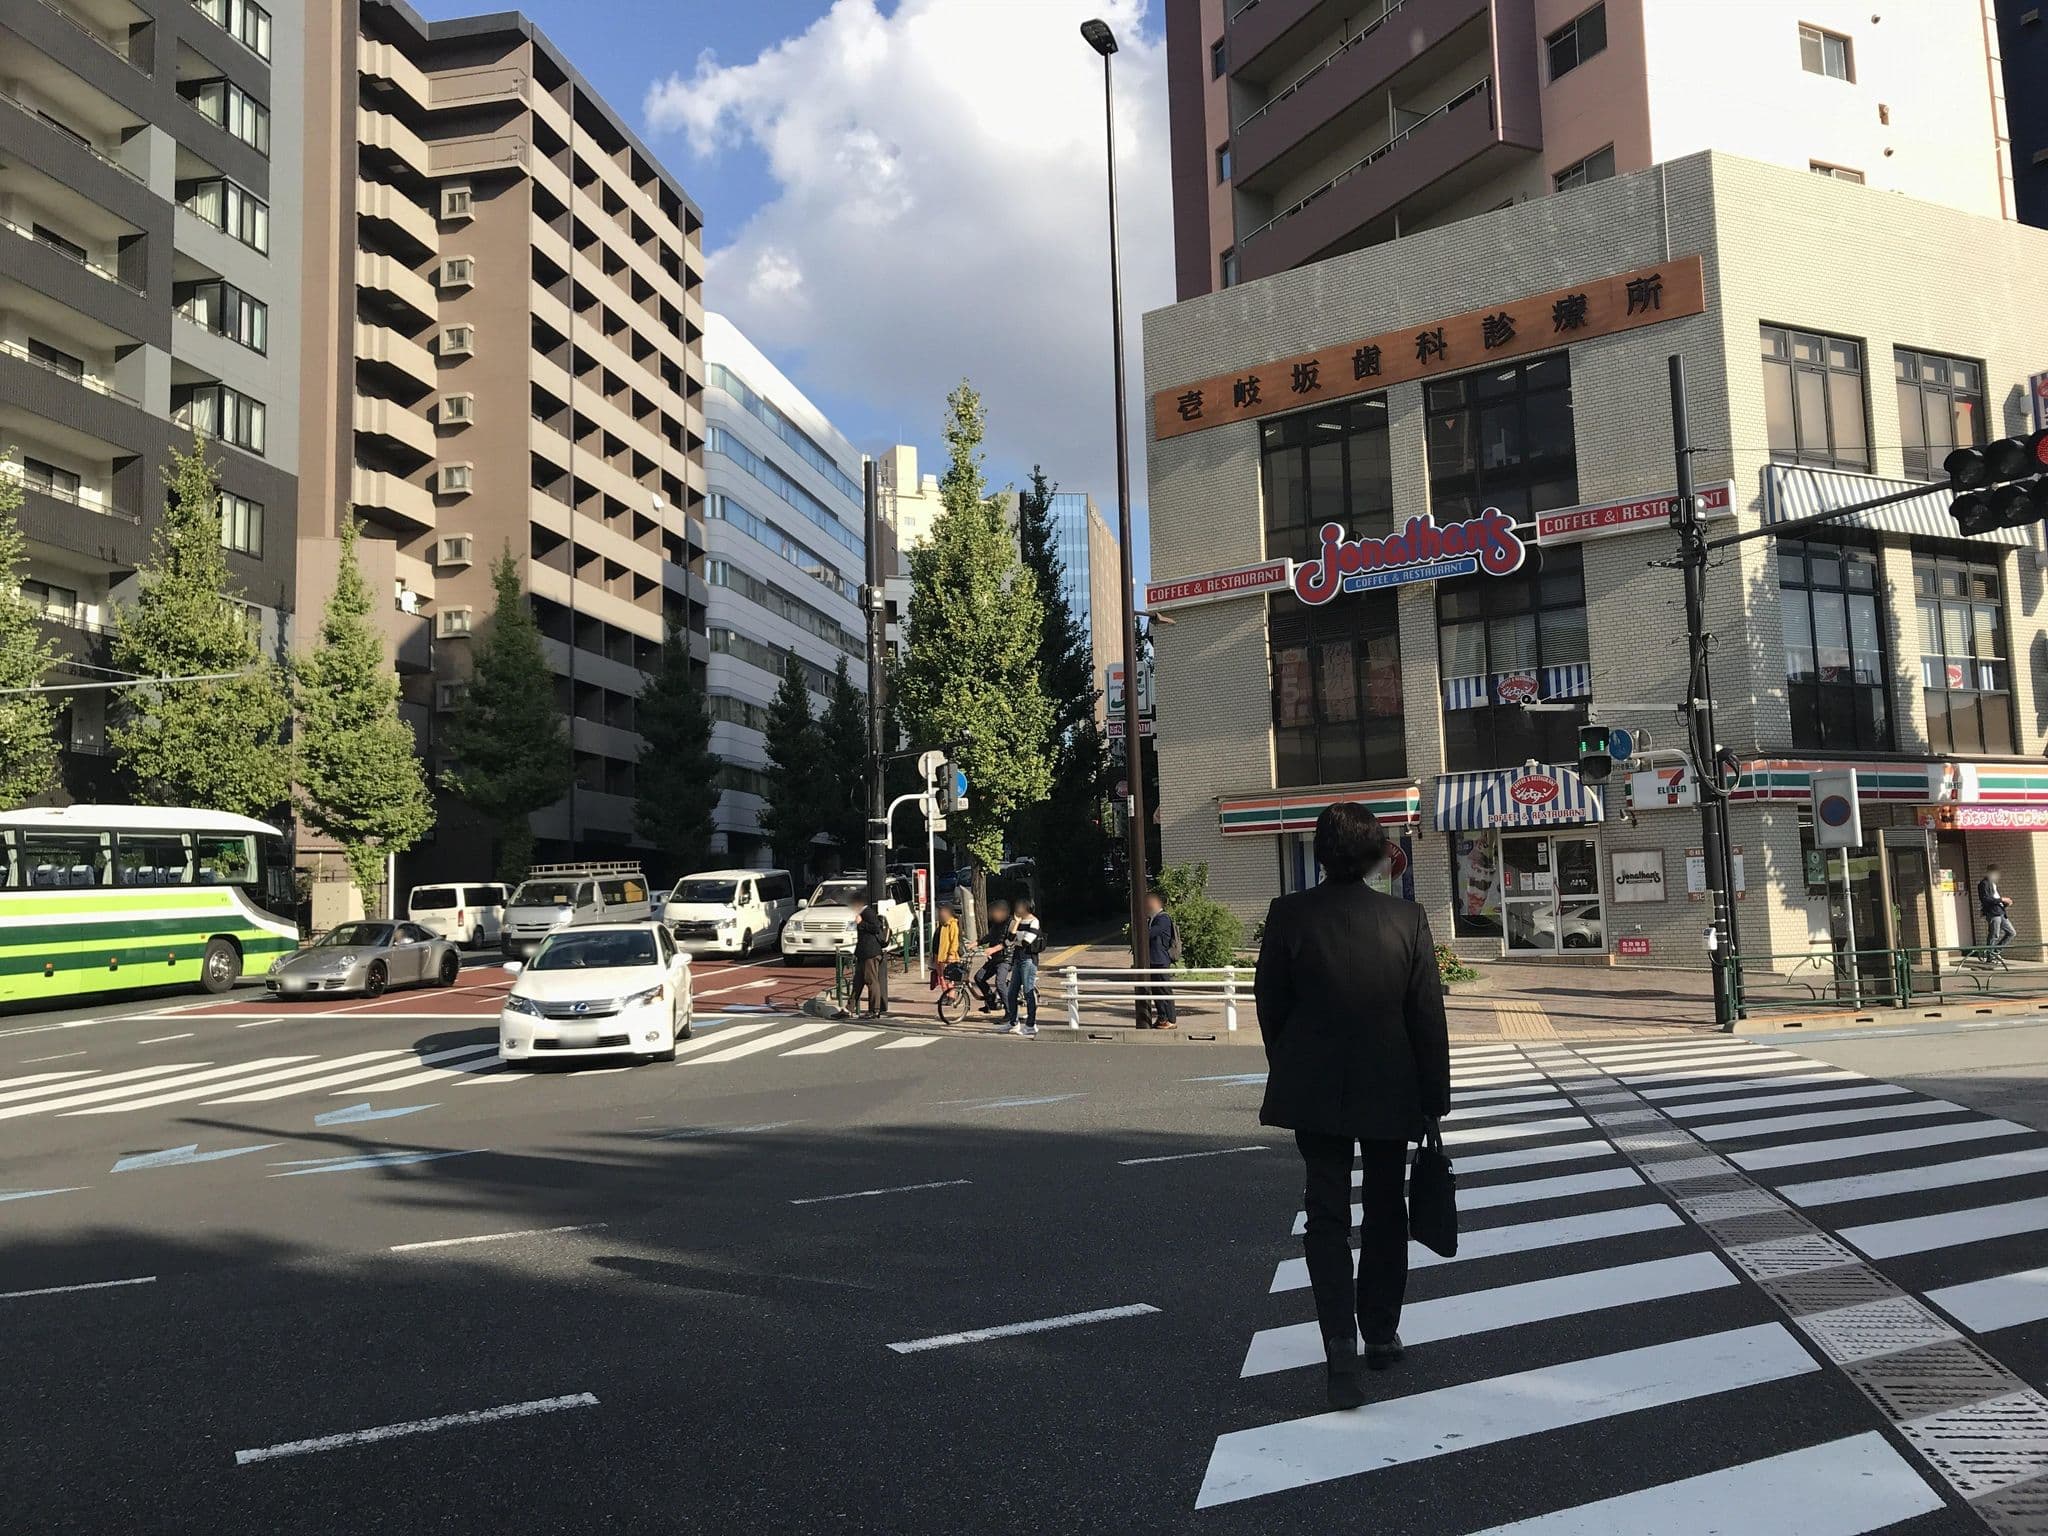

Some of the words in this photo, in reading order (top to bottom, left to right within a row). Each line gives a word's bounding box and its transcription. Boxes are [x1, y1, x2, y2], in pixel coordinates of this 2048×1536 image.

[1177, 273, 1663, 421] 壱岐坂歯科診療所
[1545, 513, 1598, 533] COFFEE
[1604, 511, 1616, 523] &
[1622, 492, 1723, 520] RESTANT
[1150, 584, 1190, 602] COFFEE
[1193, 583, 1203, 594] &
[1207, 568, 1281, 591] RESTAURANT
[1355, 575, 1389, 588] COFFEE
[1392, 573, 1399, 582] &
[1403, 563, 1464, 580] RESTAURANT
[1488, 813, 1519, 823] COFFEE
[1522, 812, 1529, 821] &
[1532, 808, 1585, 820] RESTAURANT
[1616, 869, 1661, 884] Jonathan's
